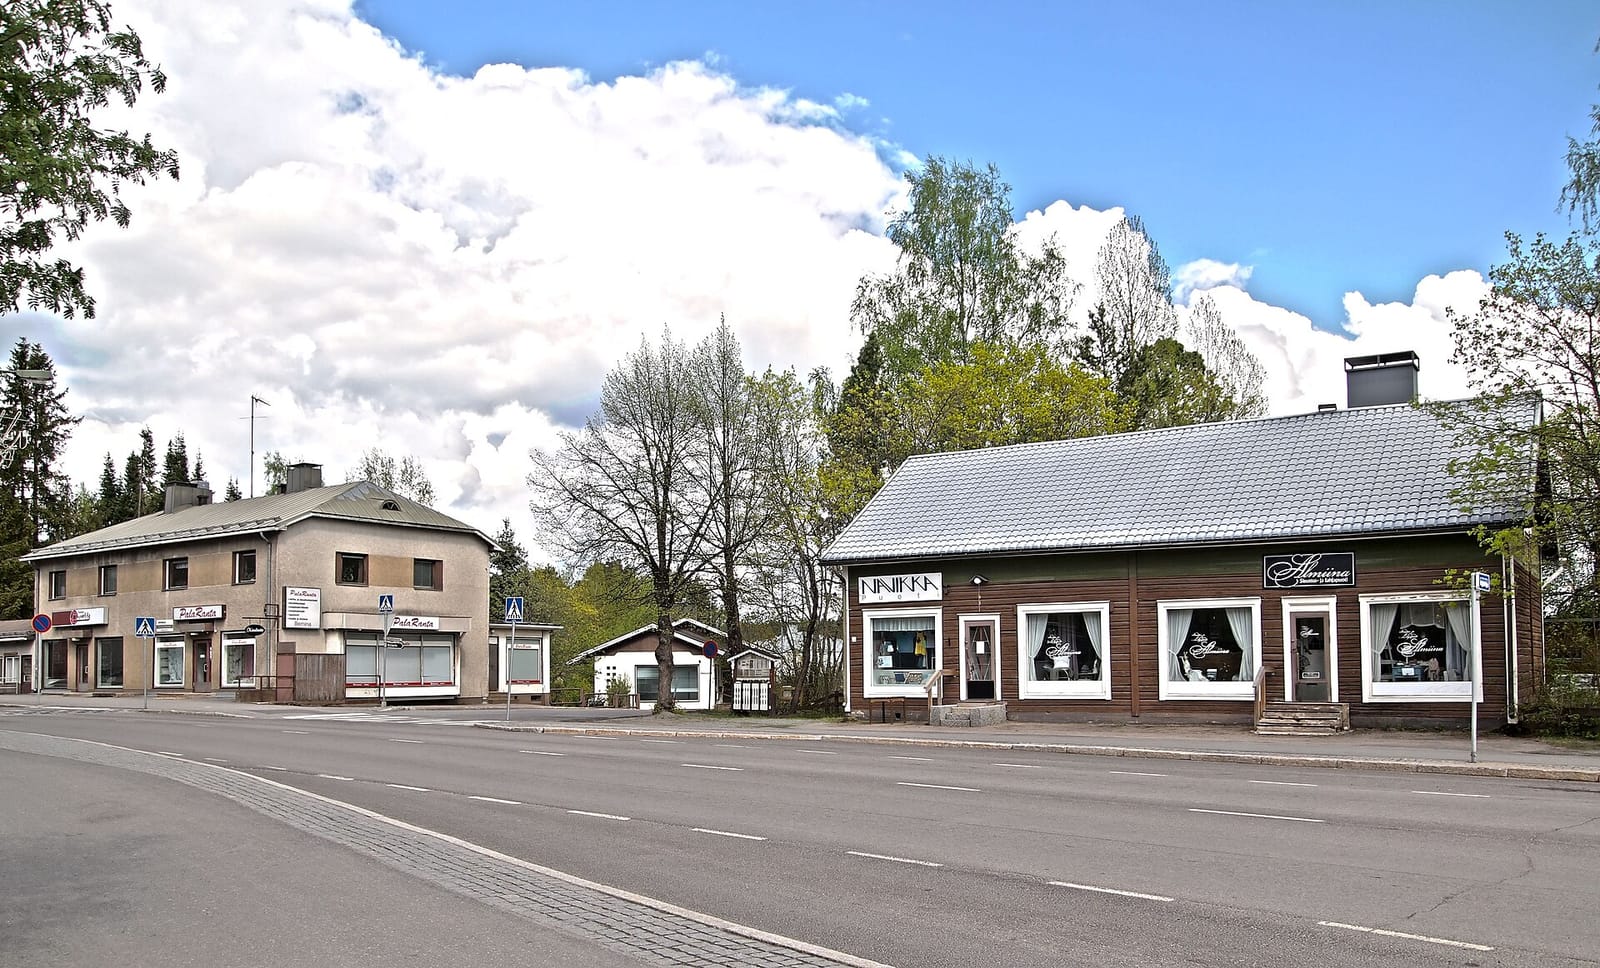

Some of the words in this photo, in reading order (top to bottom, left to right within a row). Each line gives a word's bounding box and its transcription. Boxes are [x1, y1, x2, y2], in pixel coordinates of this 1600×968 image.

[1267, 553, 1352, 587] Almiina
[861, 575, 939, 595] NAVIKKA
[179, 607, 217, 619] PalaRanta
[393, 617, 434, 628] PalaRanta
